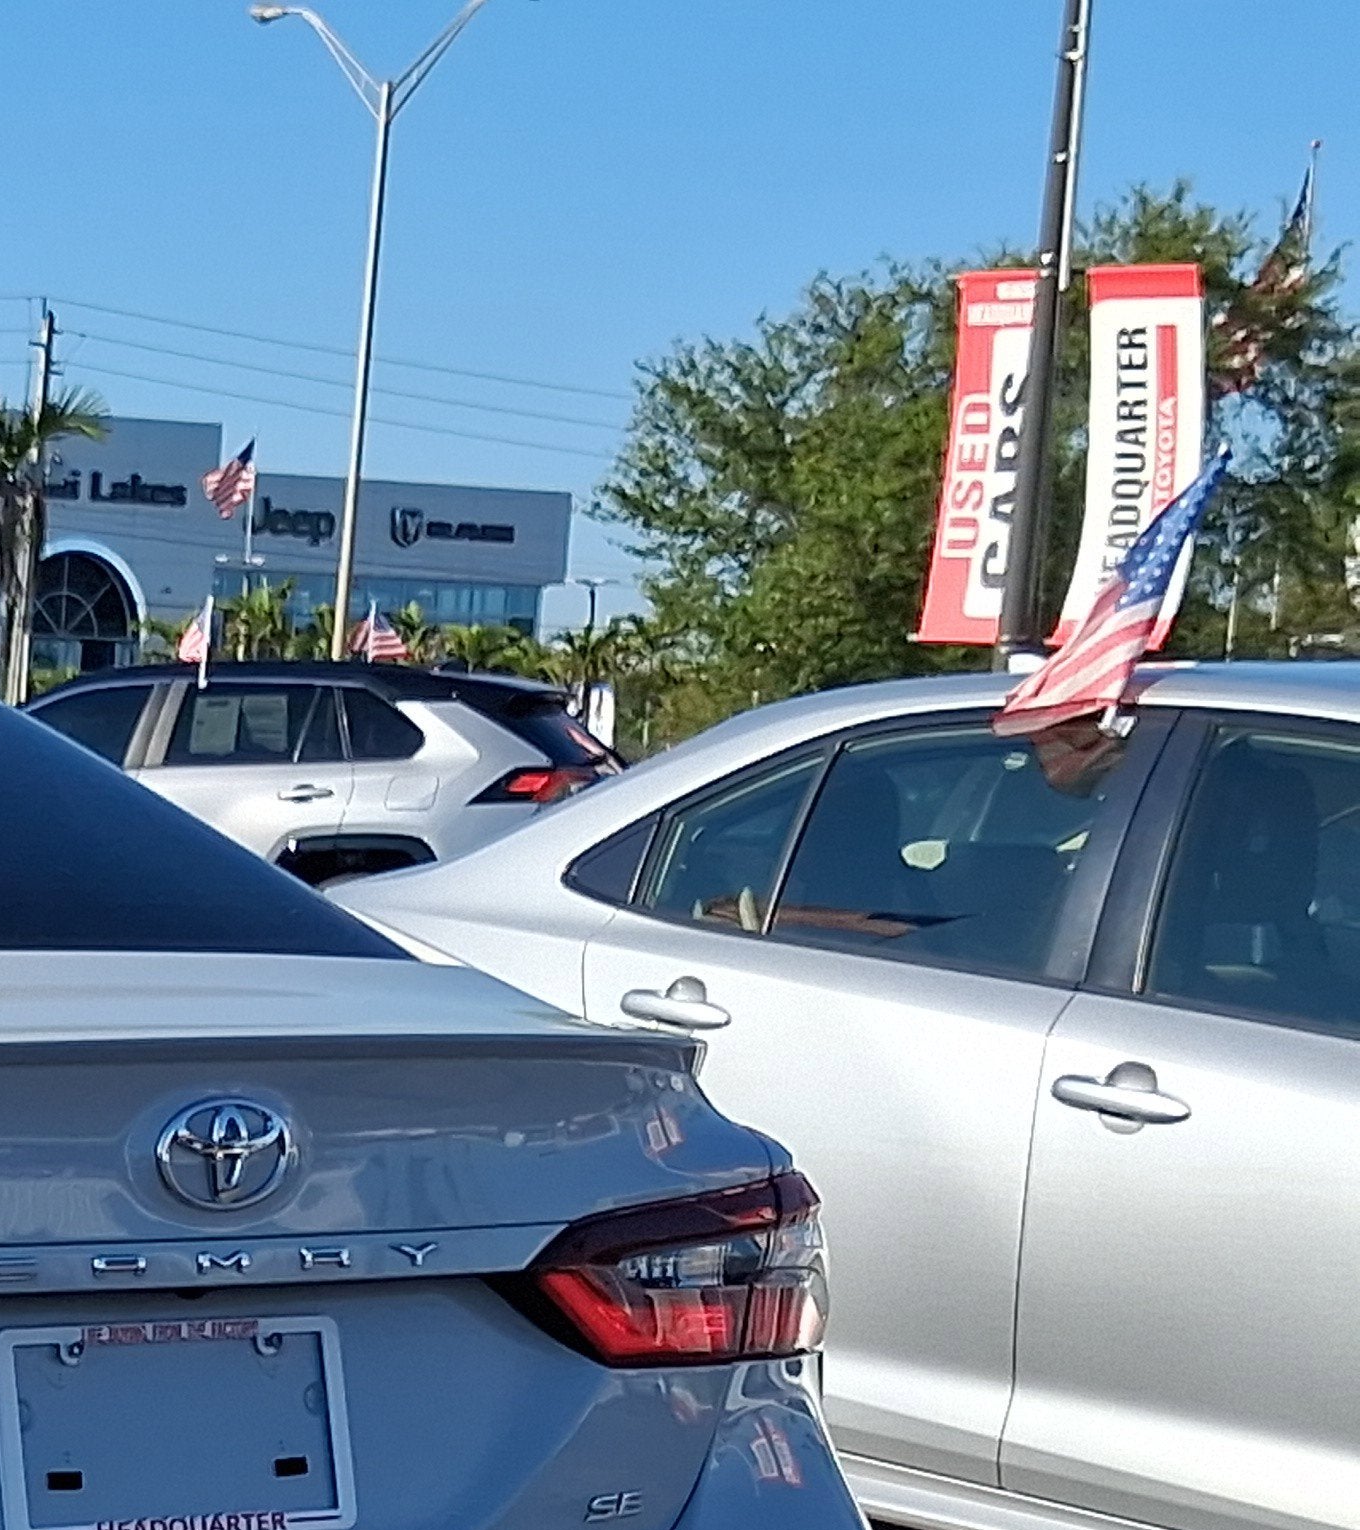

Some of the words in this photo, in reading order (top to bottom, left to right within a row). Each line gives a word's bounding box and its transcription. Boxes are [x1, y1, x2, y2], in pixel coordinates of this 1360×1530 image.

[946, 402, 990, 550] USED
[242, 495, 336, 547] Jeep
[583, 1490, 641, 1523] SE
